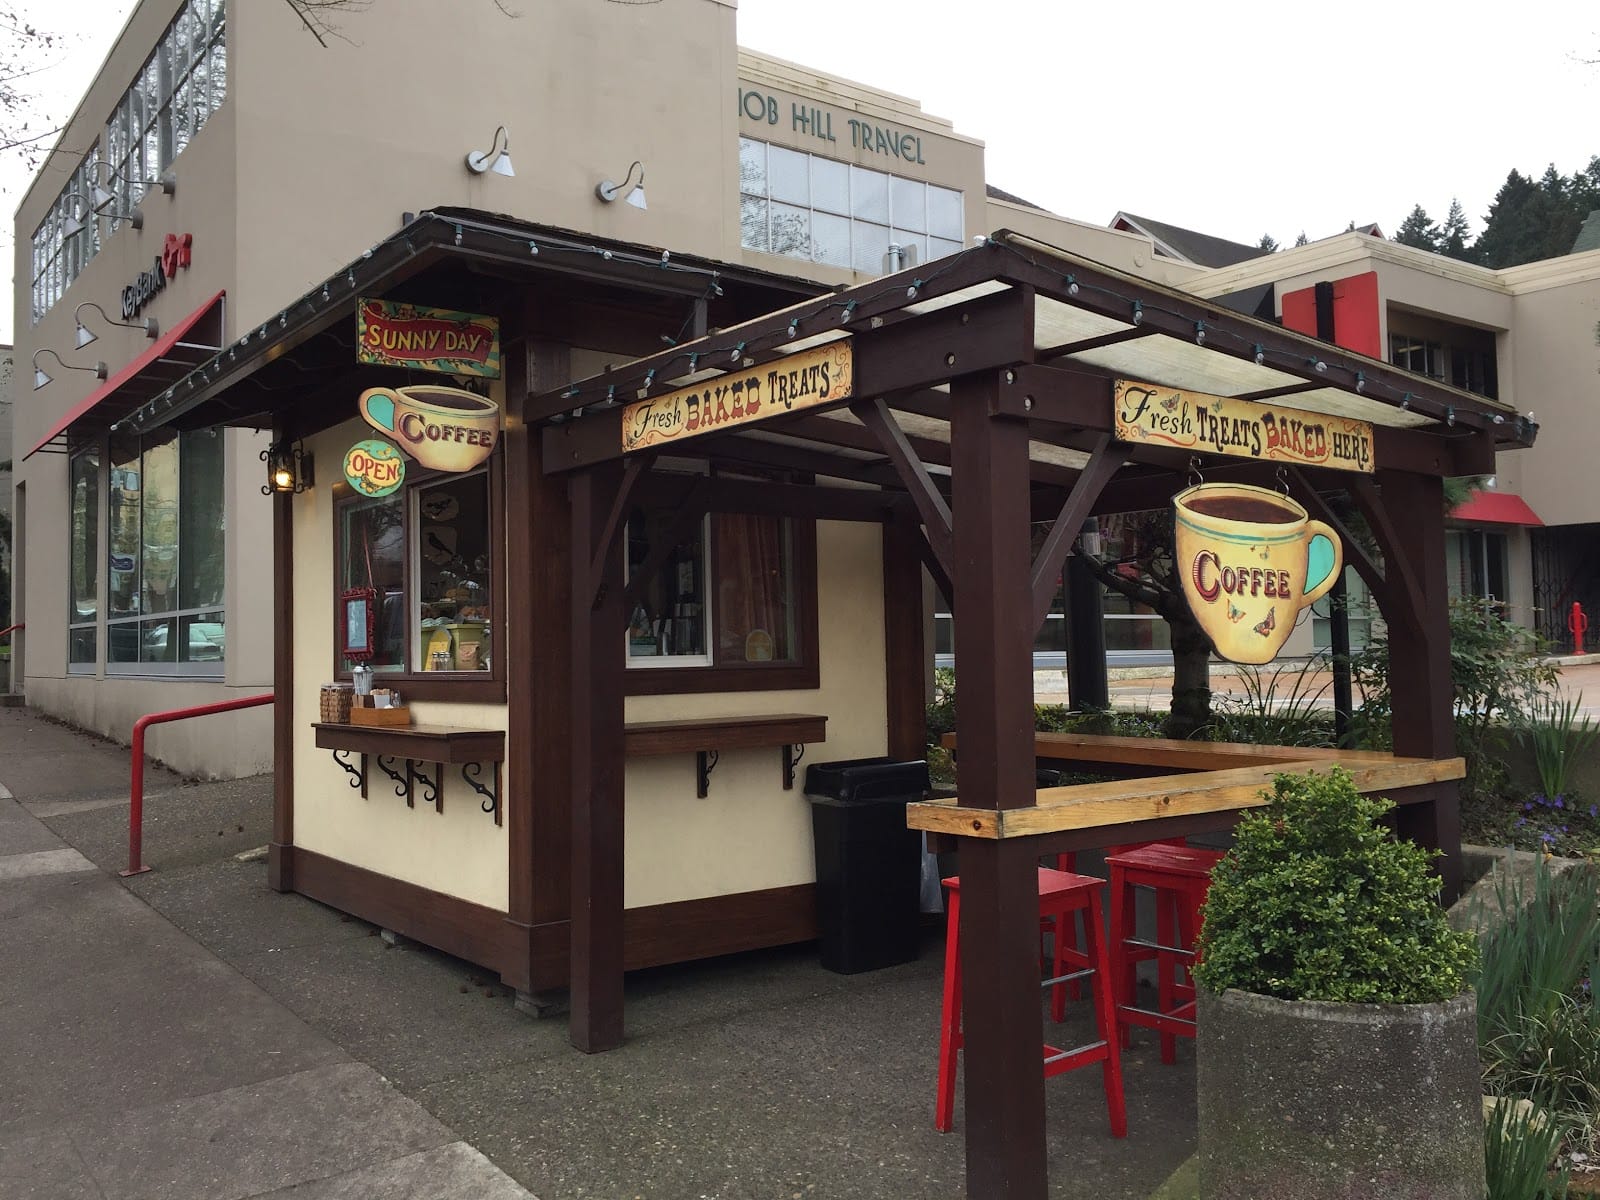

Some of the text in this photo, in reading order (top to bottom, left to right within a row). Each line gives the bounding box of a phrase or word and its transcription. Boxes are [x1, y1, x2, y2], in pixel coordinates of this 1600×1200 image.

[792, 102, 836, 142] HILL
[848, 119, 926, 165] TRAVEL
[369, 324, 483, 352] SUNNY DAY
[634, 360, 830, 439] Fresh BAKED TREATS
[399, 412, 493, 448] COFFEE
[1121, 386, 1370, 471] Fresh TREATS BAKED HERE
[352, 454, 398, 481] OPEN
[1192, 549, 1292, 603] COFFEE
